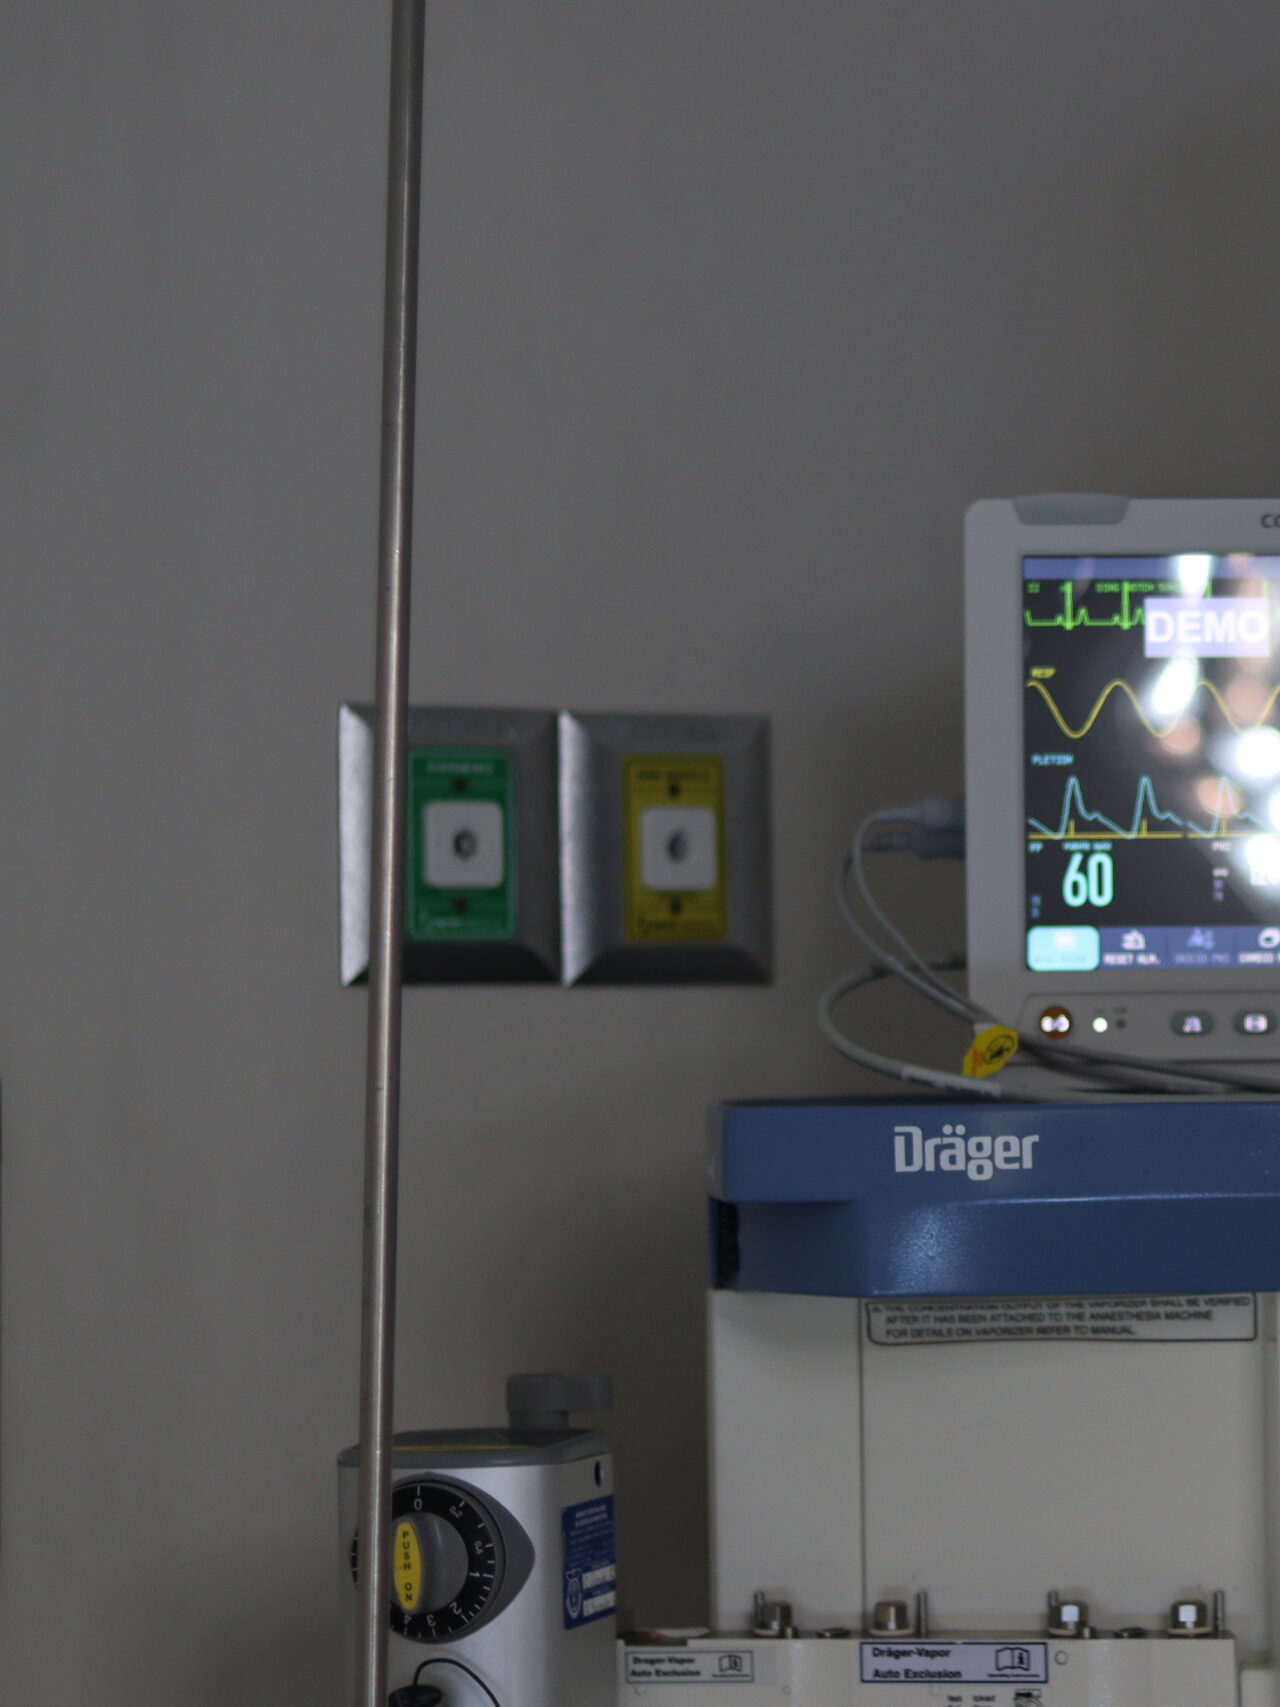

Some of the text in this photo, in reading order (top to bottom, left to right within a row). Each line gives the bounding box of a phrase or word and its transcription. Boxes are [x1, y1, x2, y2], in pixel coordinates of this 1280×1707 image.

[1146, 609, 1269, 643] DEMO
[1062, 852, 1114, 907] 60
[1104, 954, 1134, 964] RESET
[894, 1124, 1040, 1181] Dräger
[1204, 1296, 1249, 1306] VERIFIED
[886, 1315, 918, 1324] AFTER
[934, 1314, 955, 1323] HAS
[958, 1314, 986, 1323] BEEN
[990, 1313, 1045, 1322] ATTACHED
[1049, 1313, 1062, 1321] TO
[1065, 1312, 1085, 1321] THE
[1164, 1310, 1213, 1320] MACHINE
[886, 1328, 908, 1338] FOR
[911, 1328, 954, 1337] DETAILS
[956, 1327, 972, 1336] ON
[975, 1327, 1032, 1336] VAPORIZER
[1037, 1325, 1073, 1335] REFER
[1075, 1326, 1088, 1334] TO
[414, 1498, 423, 1510] 0
[402, 1530, 412, 1601] PUSH ON
[450, 1601, 461, 1615] 2
[426, 1615, 437, 1627] 3
[631, 1669, 701, 1677] Auto Exclusion
[873, 1668, 962, 1679] Auto Exclusion
